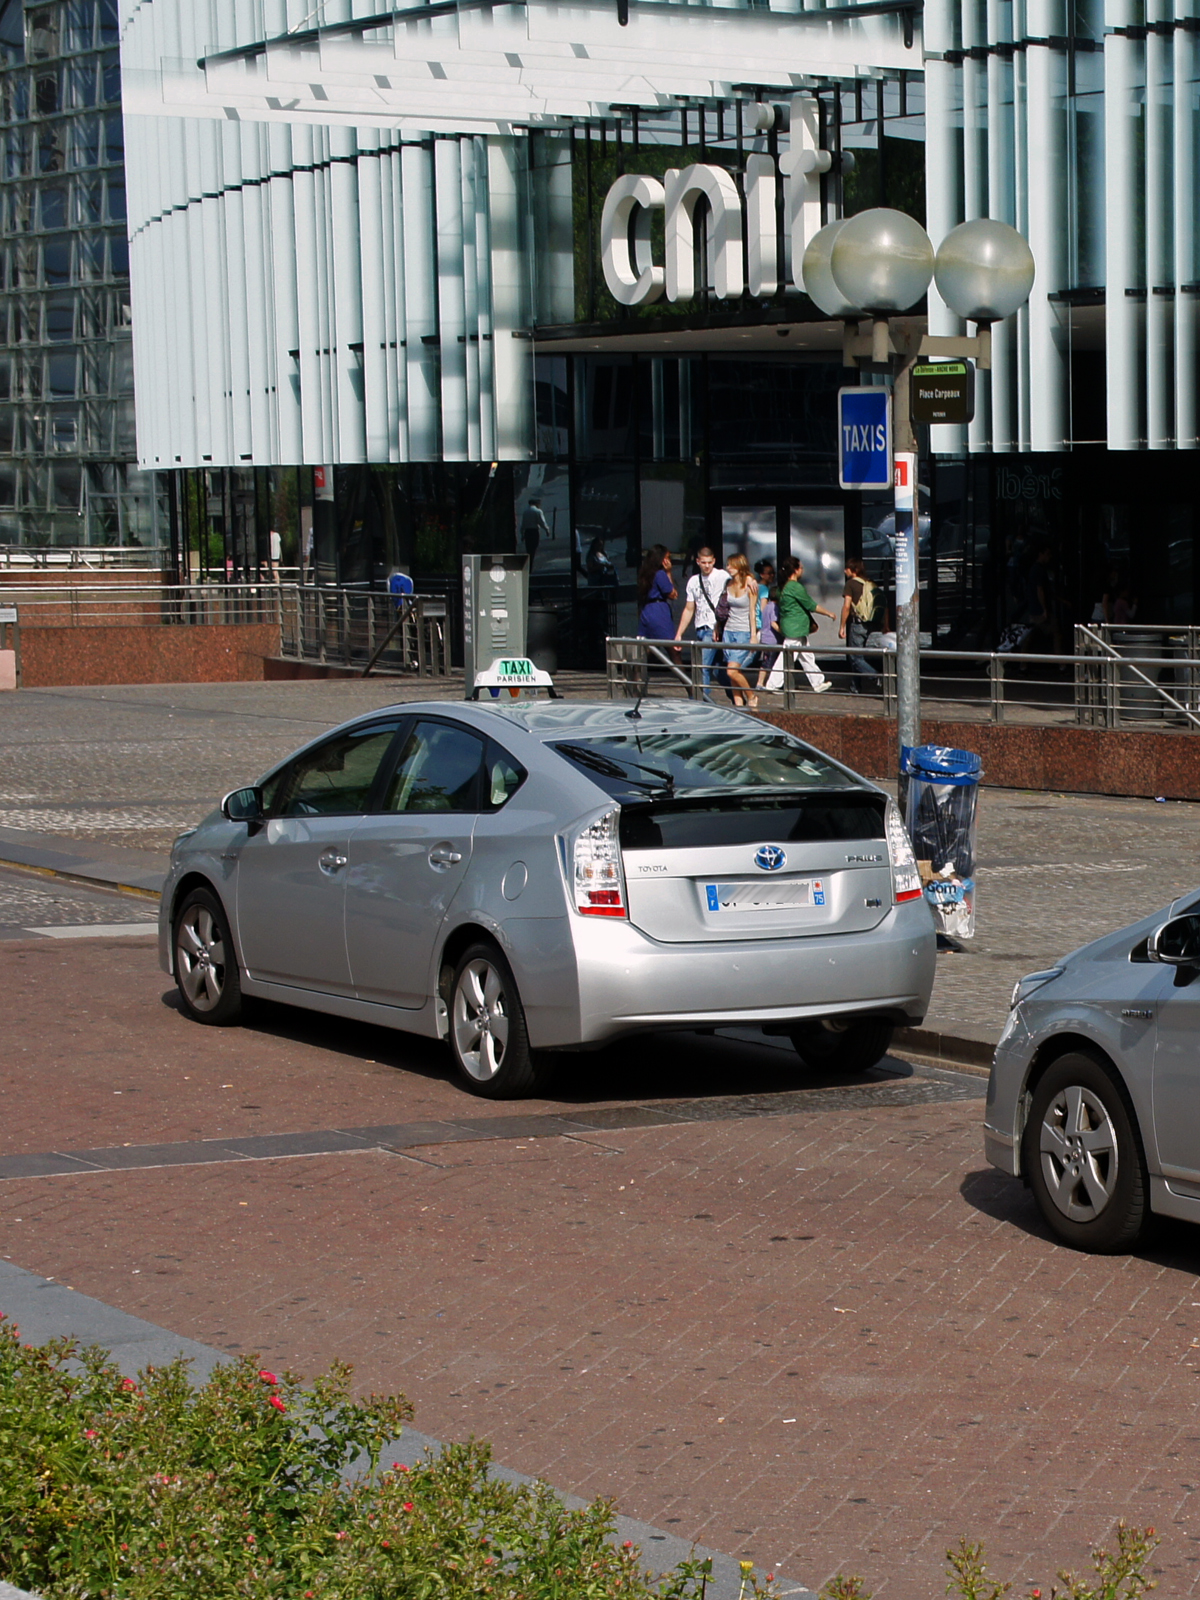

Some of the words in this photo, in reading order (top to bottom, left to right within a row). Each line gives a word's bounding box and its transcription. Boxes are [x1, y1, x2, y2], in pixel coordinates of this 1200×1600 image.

[919, 389, 934, 398] Place
[934, 388, 960, 400] Carpeaux
[843, 424, 886, 452] TAXIS
[501, 660, 530, 674] TAXI
[845, 854, 882, 864] PRIUS
[638, 865, 668, 873] TOYOTA
[814, 893, 824, 904] 75
